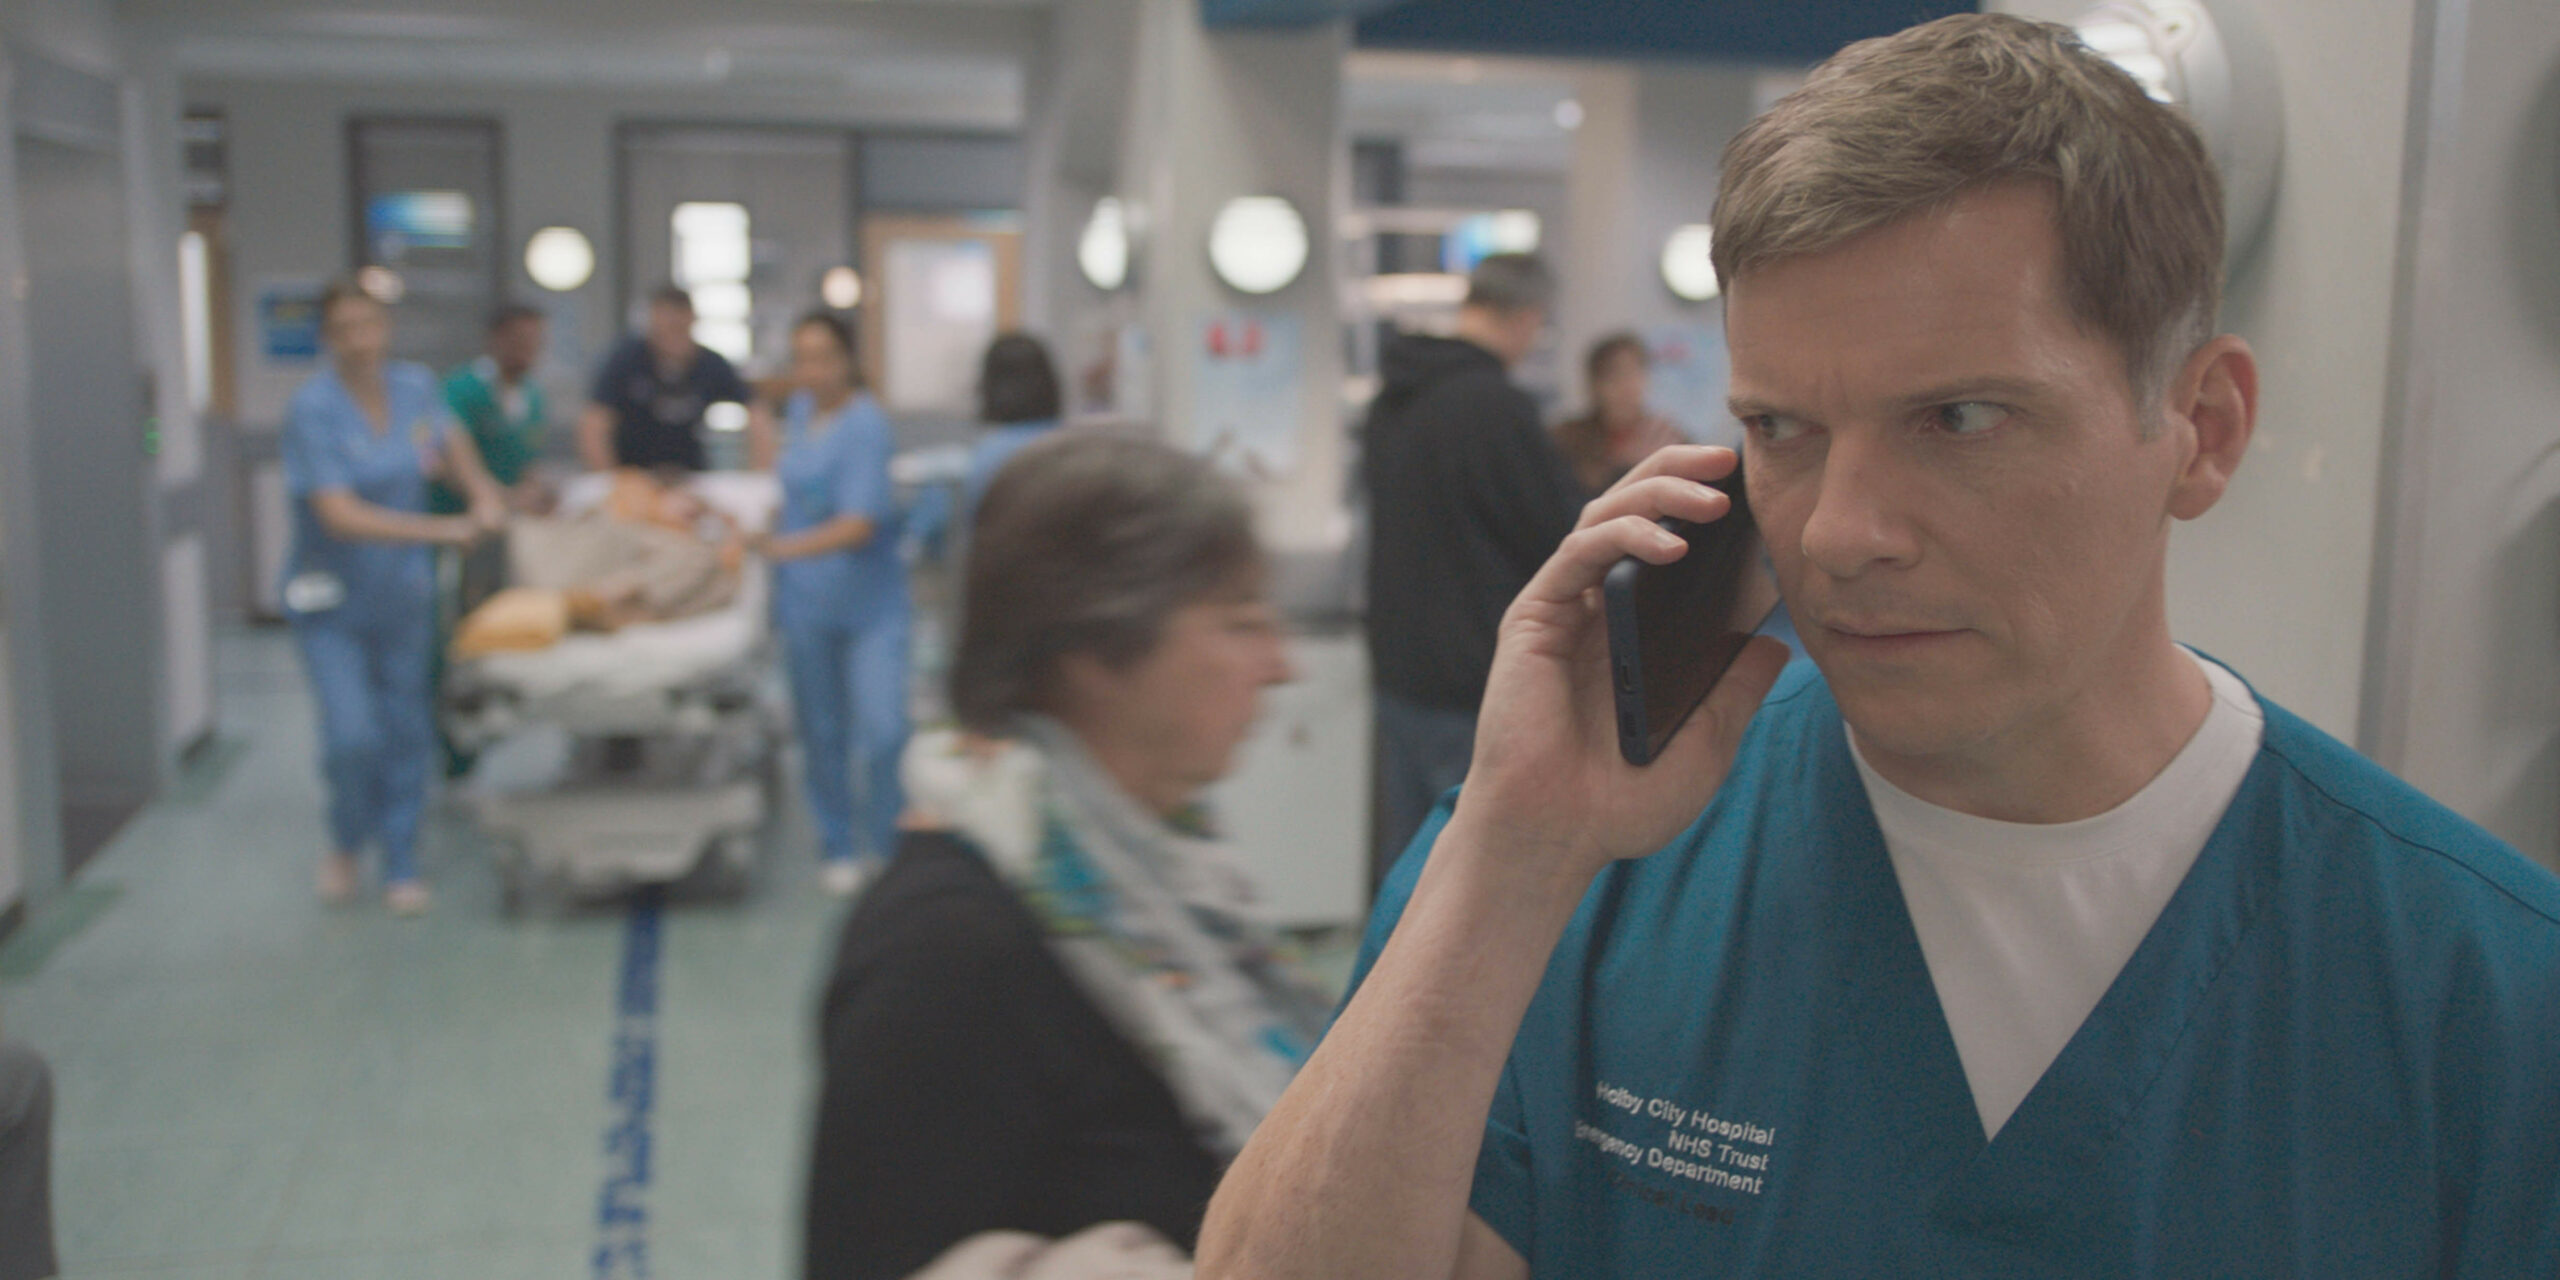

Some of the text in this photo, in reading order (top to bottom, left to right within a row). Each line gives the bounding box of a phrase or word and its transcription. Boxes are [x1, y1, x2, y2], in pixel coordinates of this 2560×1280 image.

[1596, 1080, 1776, 1146] Holby City Hospital
[1647, 1147, 1764, 1195] Department
[1667, 1129, 1769, 1171] NHS Trust
